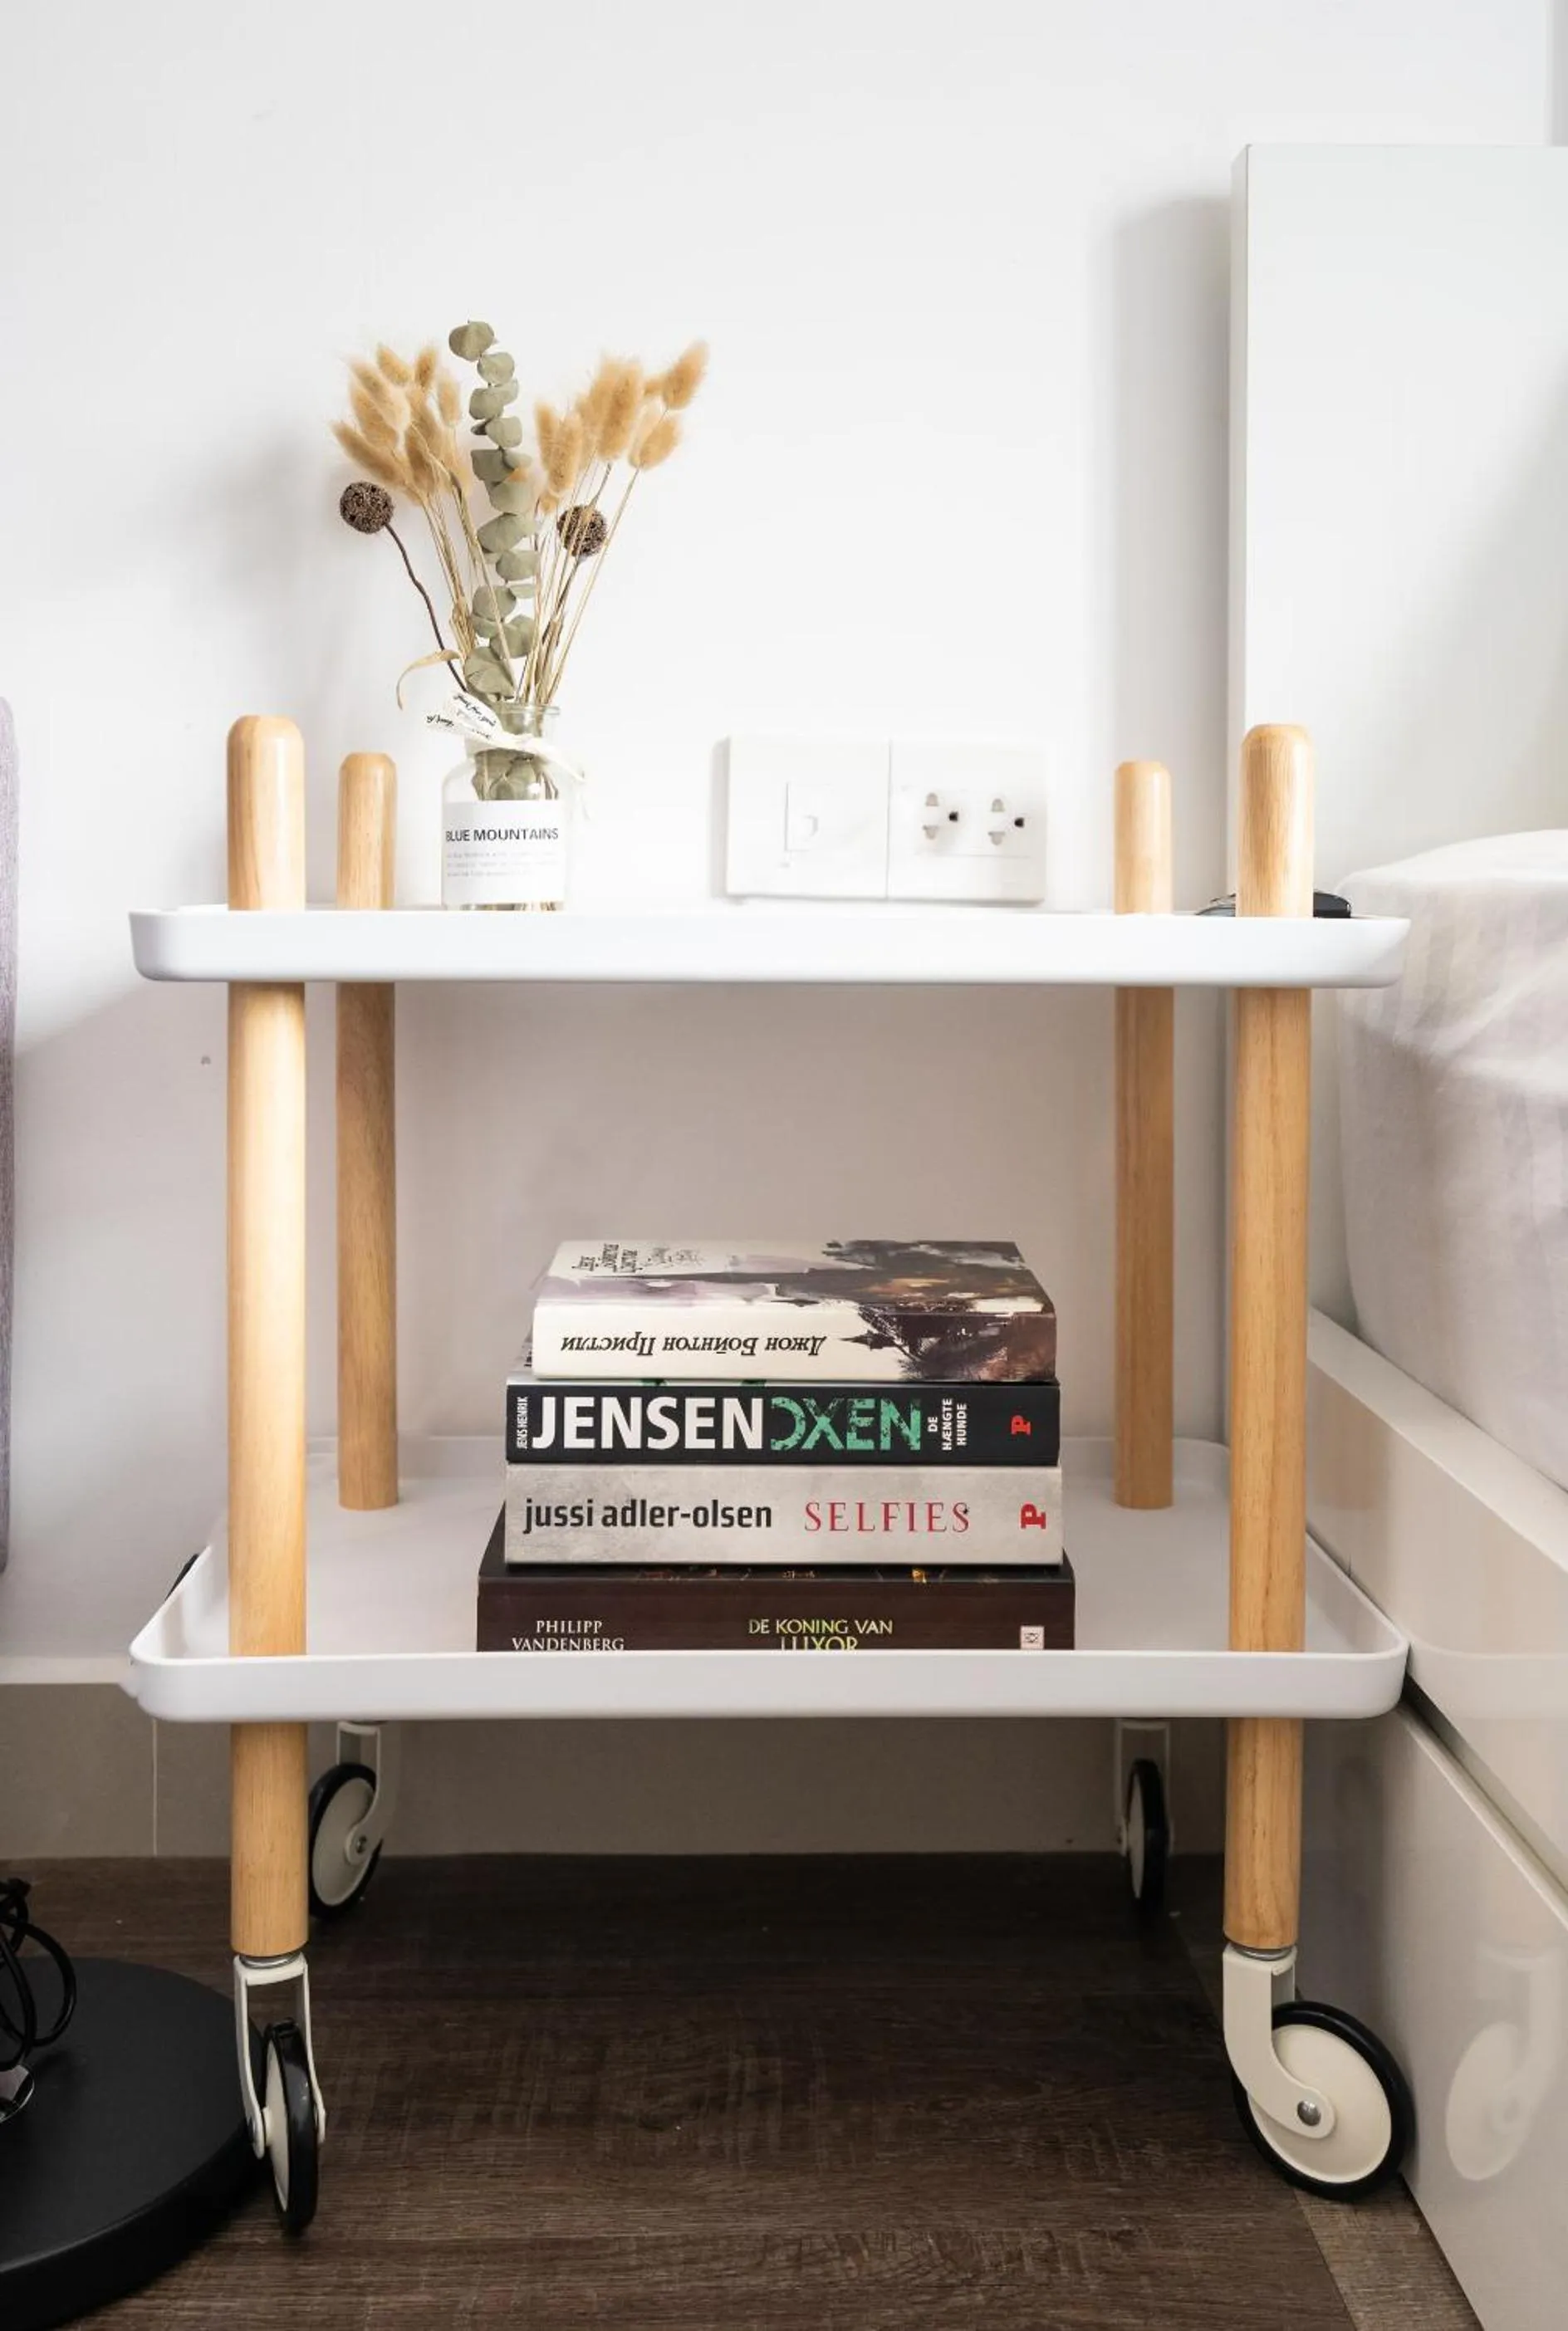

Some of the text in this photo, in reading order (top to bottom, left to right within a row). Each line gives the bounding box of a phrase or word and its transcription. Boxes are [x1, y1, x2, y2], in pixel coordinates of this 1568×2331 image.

[445, 827, 559, 842] BLUE MOUNTAINS
[560, 1331, 827, 1356] Джон Бойнтон Пристли
[516, 1396, 528, 1428] HENRIK
[532, 1396, 763, 1450] JENSEN
[927, 1416, 938, 1432] DE
[941, 1398, 953, 1451] HÆNGTE
[956, 1403, 968, 1446] HUNDE
[522, 1498, 772, 1535] jussi adler-olsen
[804, 1501, 970, 1533] SELFIES
[536, 1620, 603, 1634] PHILIPP
[748, 1618, 894, 1634] DE KONING VAN
[512, 1637, 625, 1651] VANDENBERG
